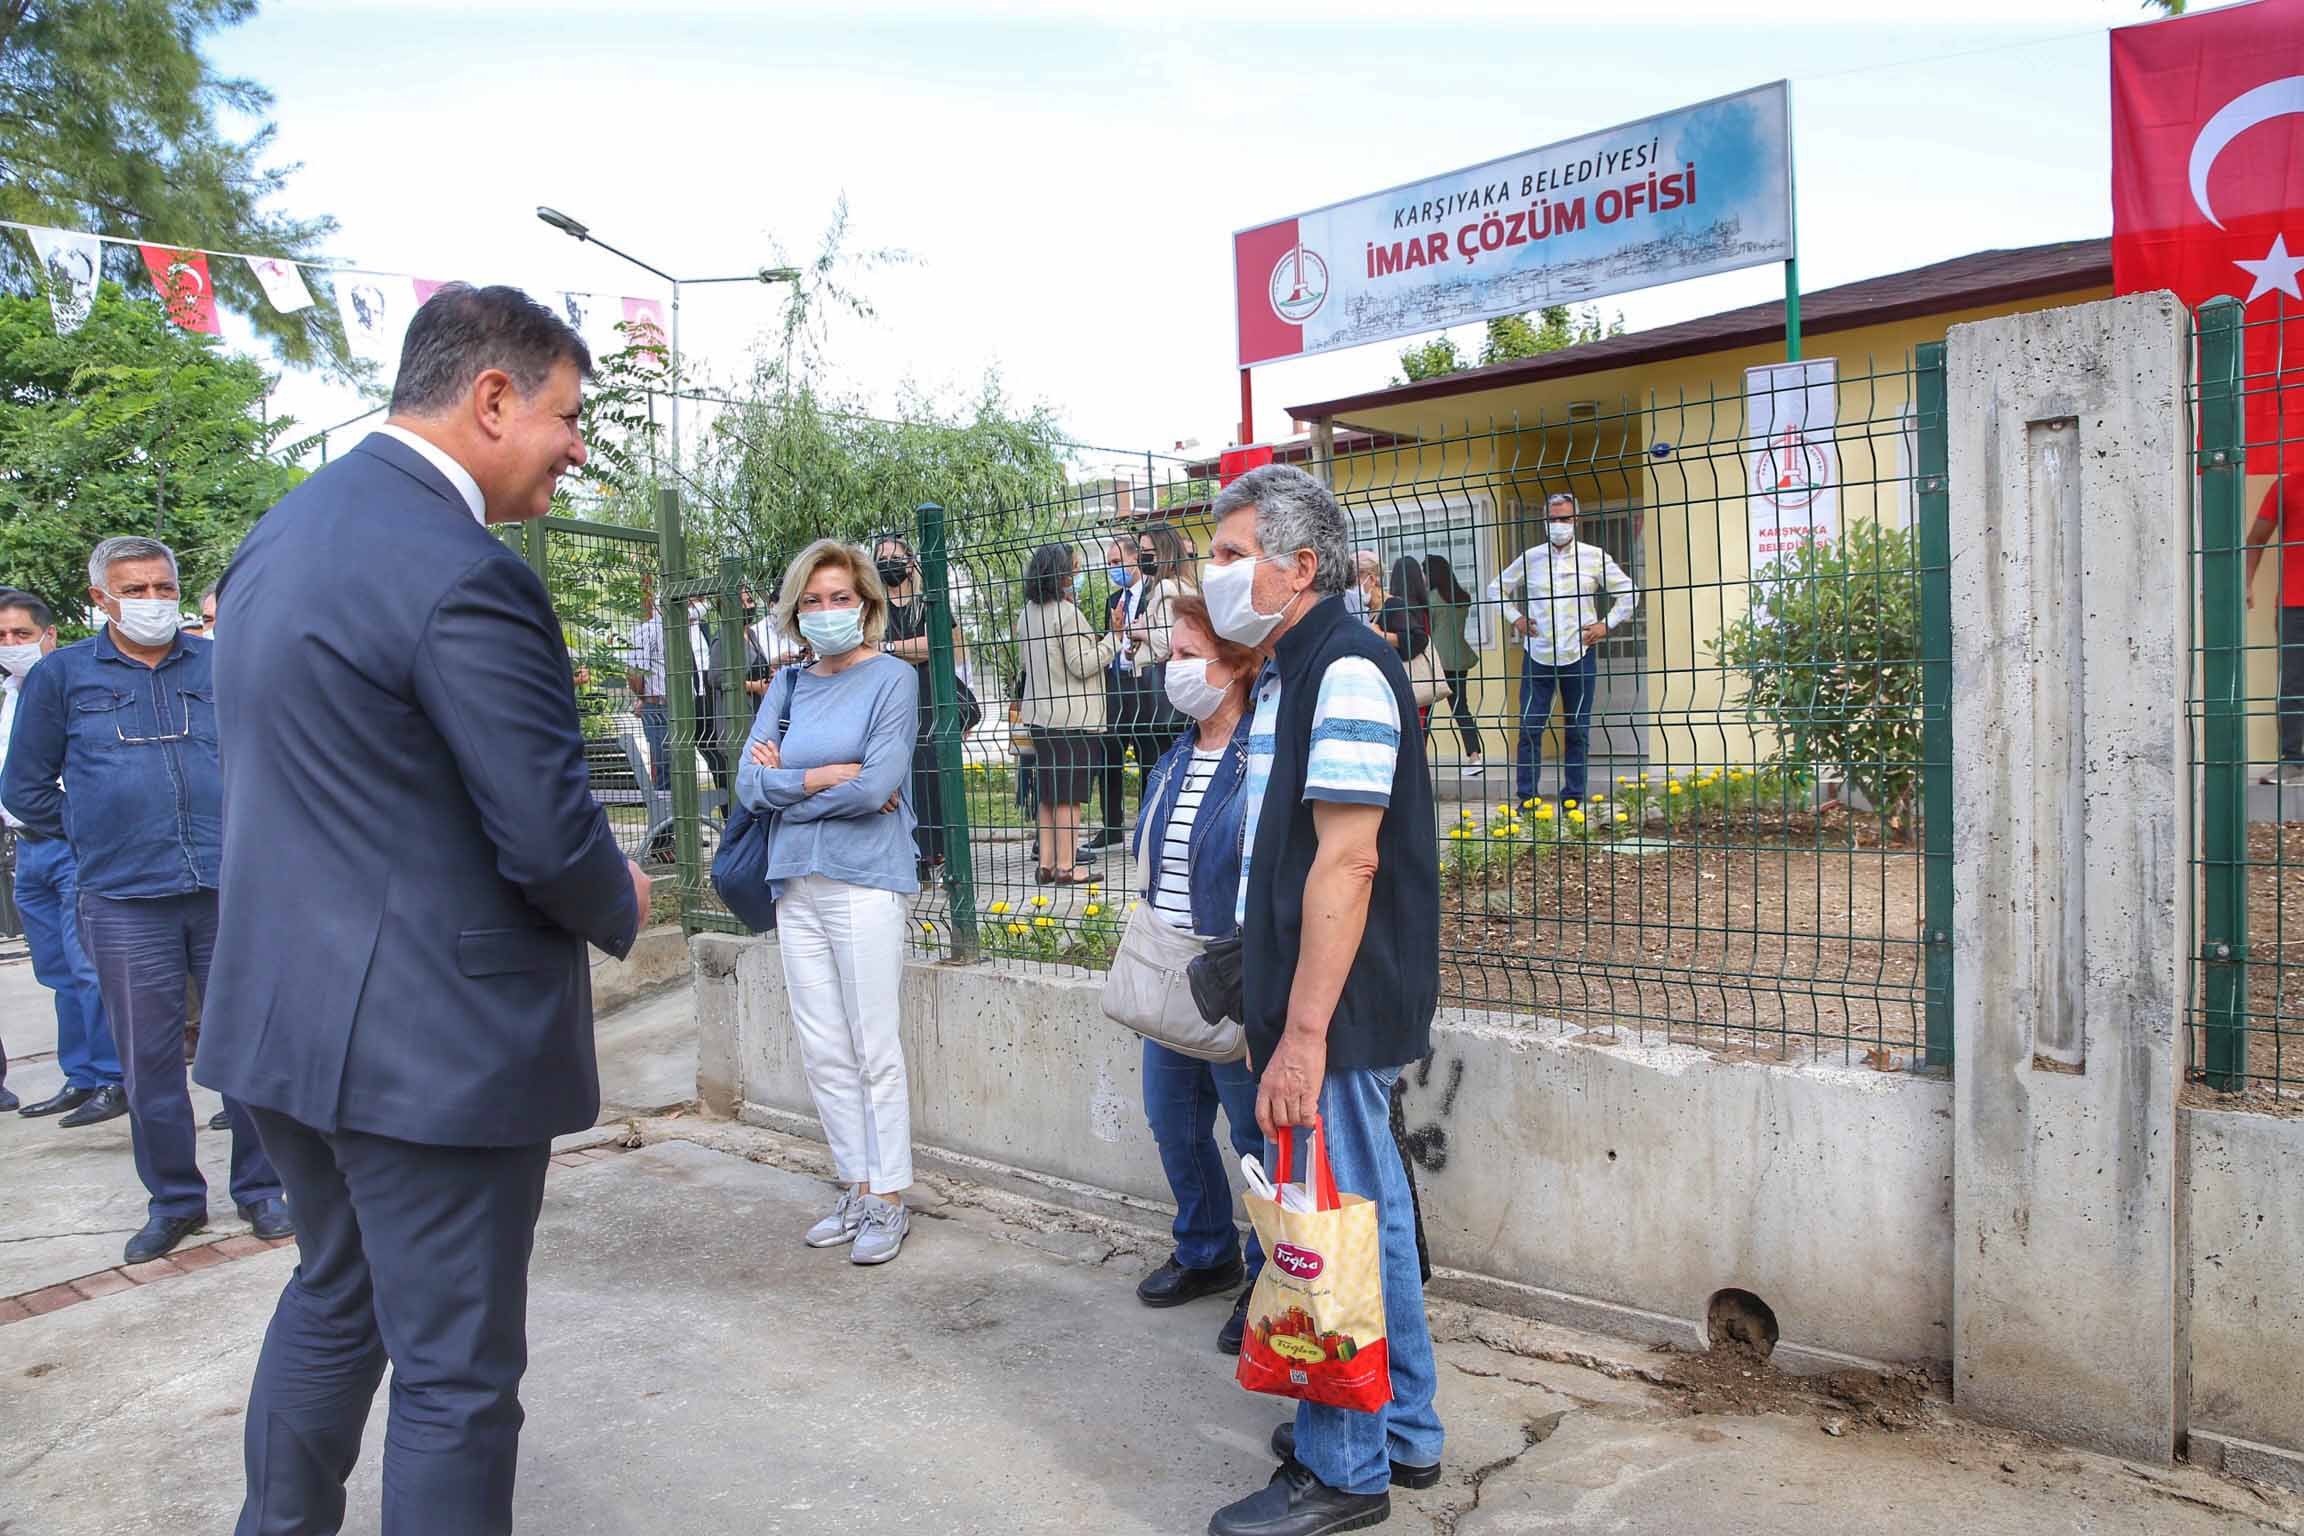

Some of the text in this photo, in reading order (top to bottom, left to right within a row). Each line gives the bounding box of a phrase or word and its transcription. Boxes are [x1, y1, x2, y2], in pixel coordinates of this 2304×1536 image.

[1365, 231, 1449, 280] İMAR
[1456, 197, 1586, 265] ÇÖZÜM
[1594, 160, 1697, 225] OFİSİ
[1393, 136, 1658, 230] KARŞIYAKA BELEDİYESİ
